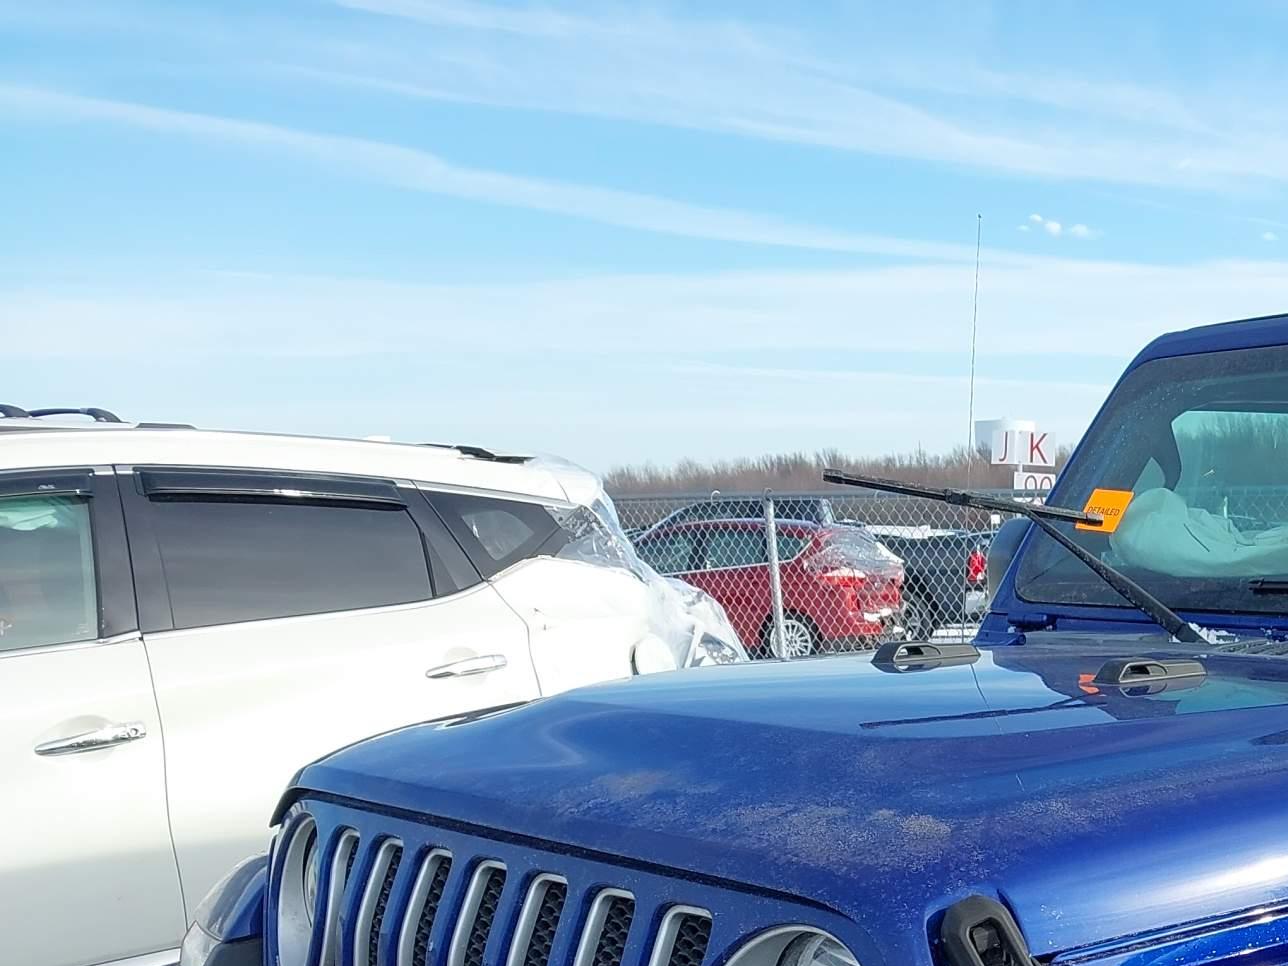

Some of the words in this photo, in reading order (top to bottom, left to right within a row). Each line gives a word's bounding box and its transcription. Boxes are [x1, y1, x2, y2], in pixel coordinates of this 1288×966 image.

[998, 431, 1008, 462] J
[1029, 432, 1048, 464] K
[1087, 506, 1120, 517] DETAILED
